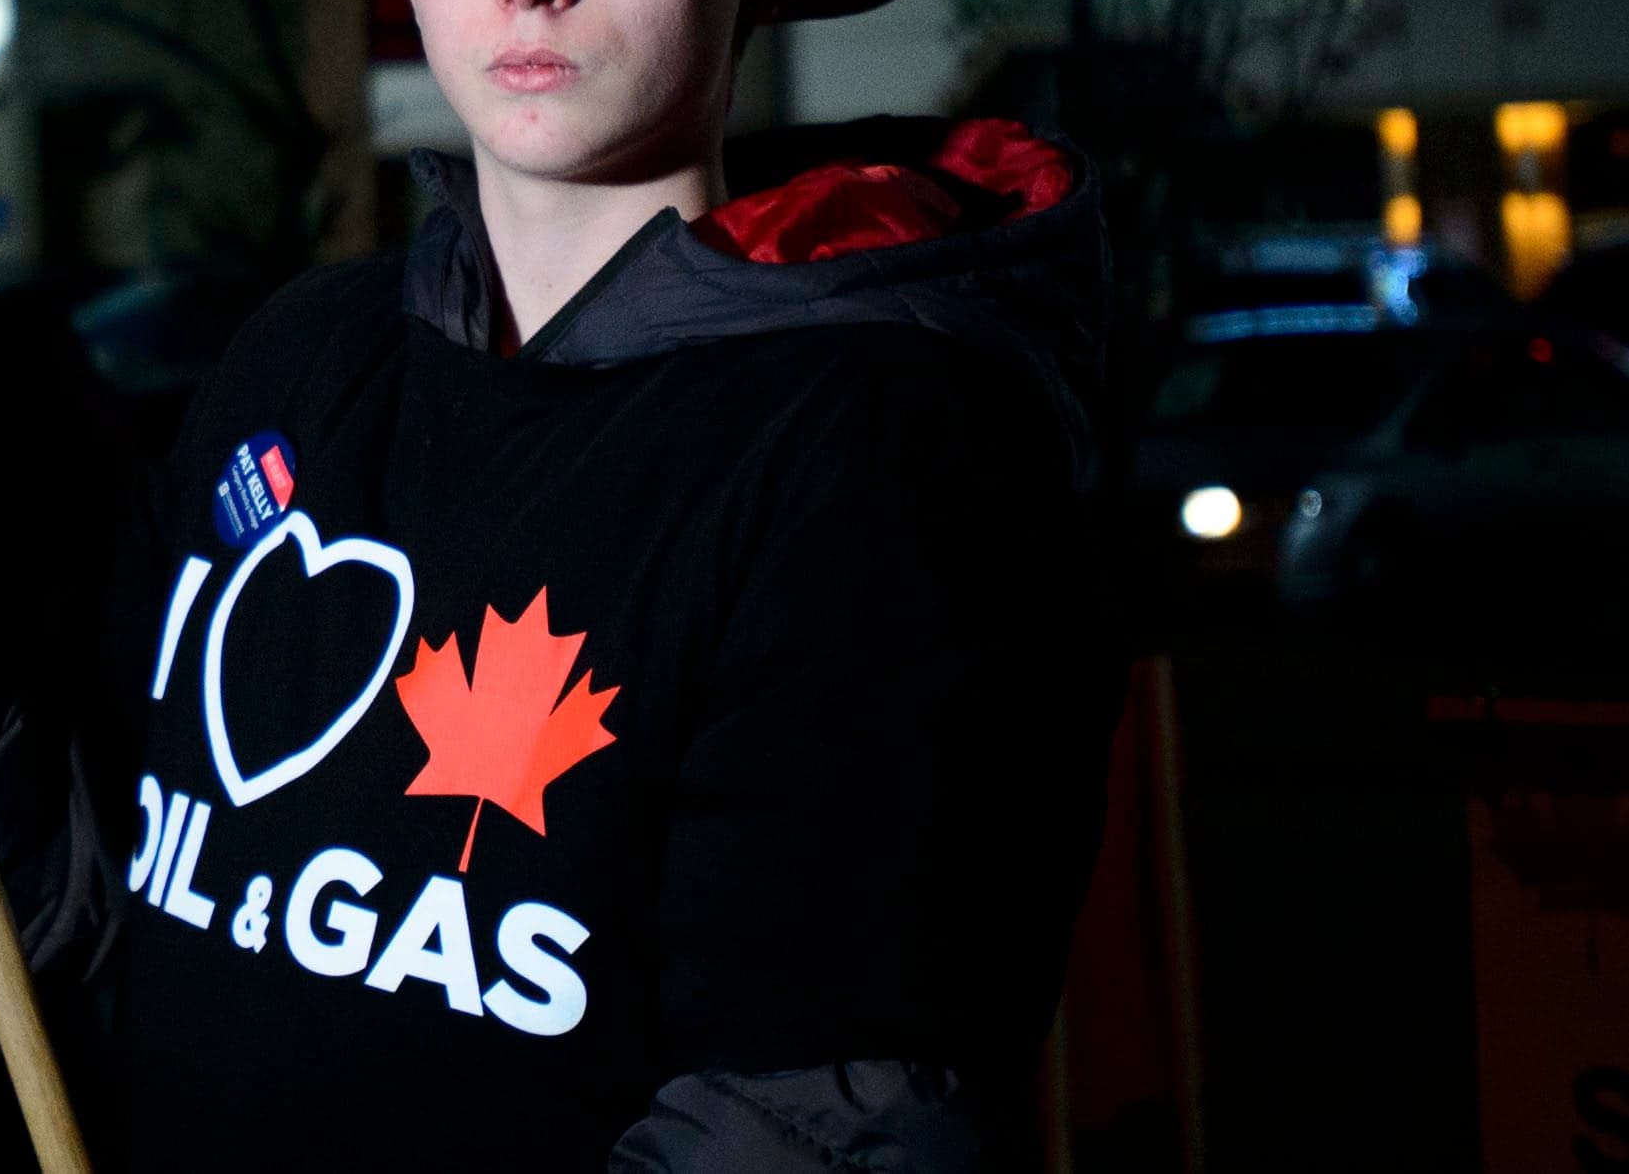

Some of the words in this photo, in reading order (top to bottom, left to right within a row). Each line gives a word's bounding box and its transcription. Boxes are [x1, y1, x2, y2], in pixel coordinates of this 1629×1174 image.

[237, 443, 256, 476] PAT
[247, 472, 274, 521] KELLY
[151, 555, 213, 701] I
[232, 874, 273, 954] &
[284, 847, 592, 1037] GAS
